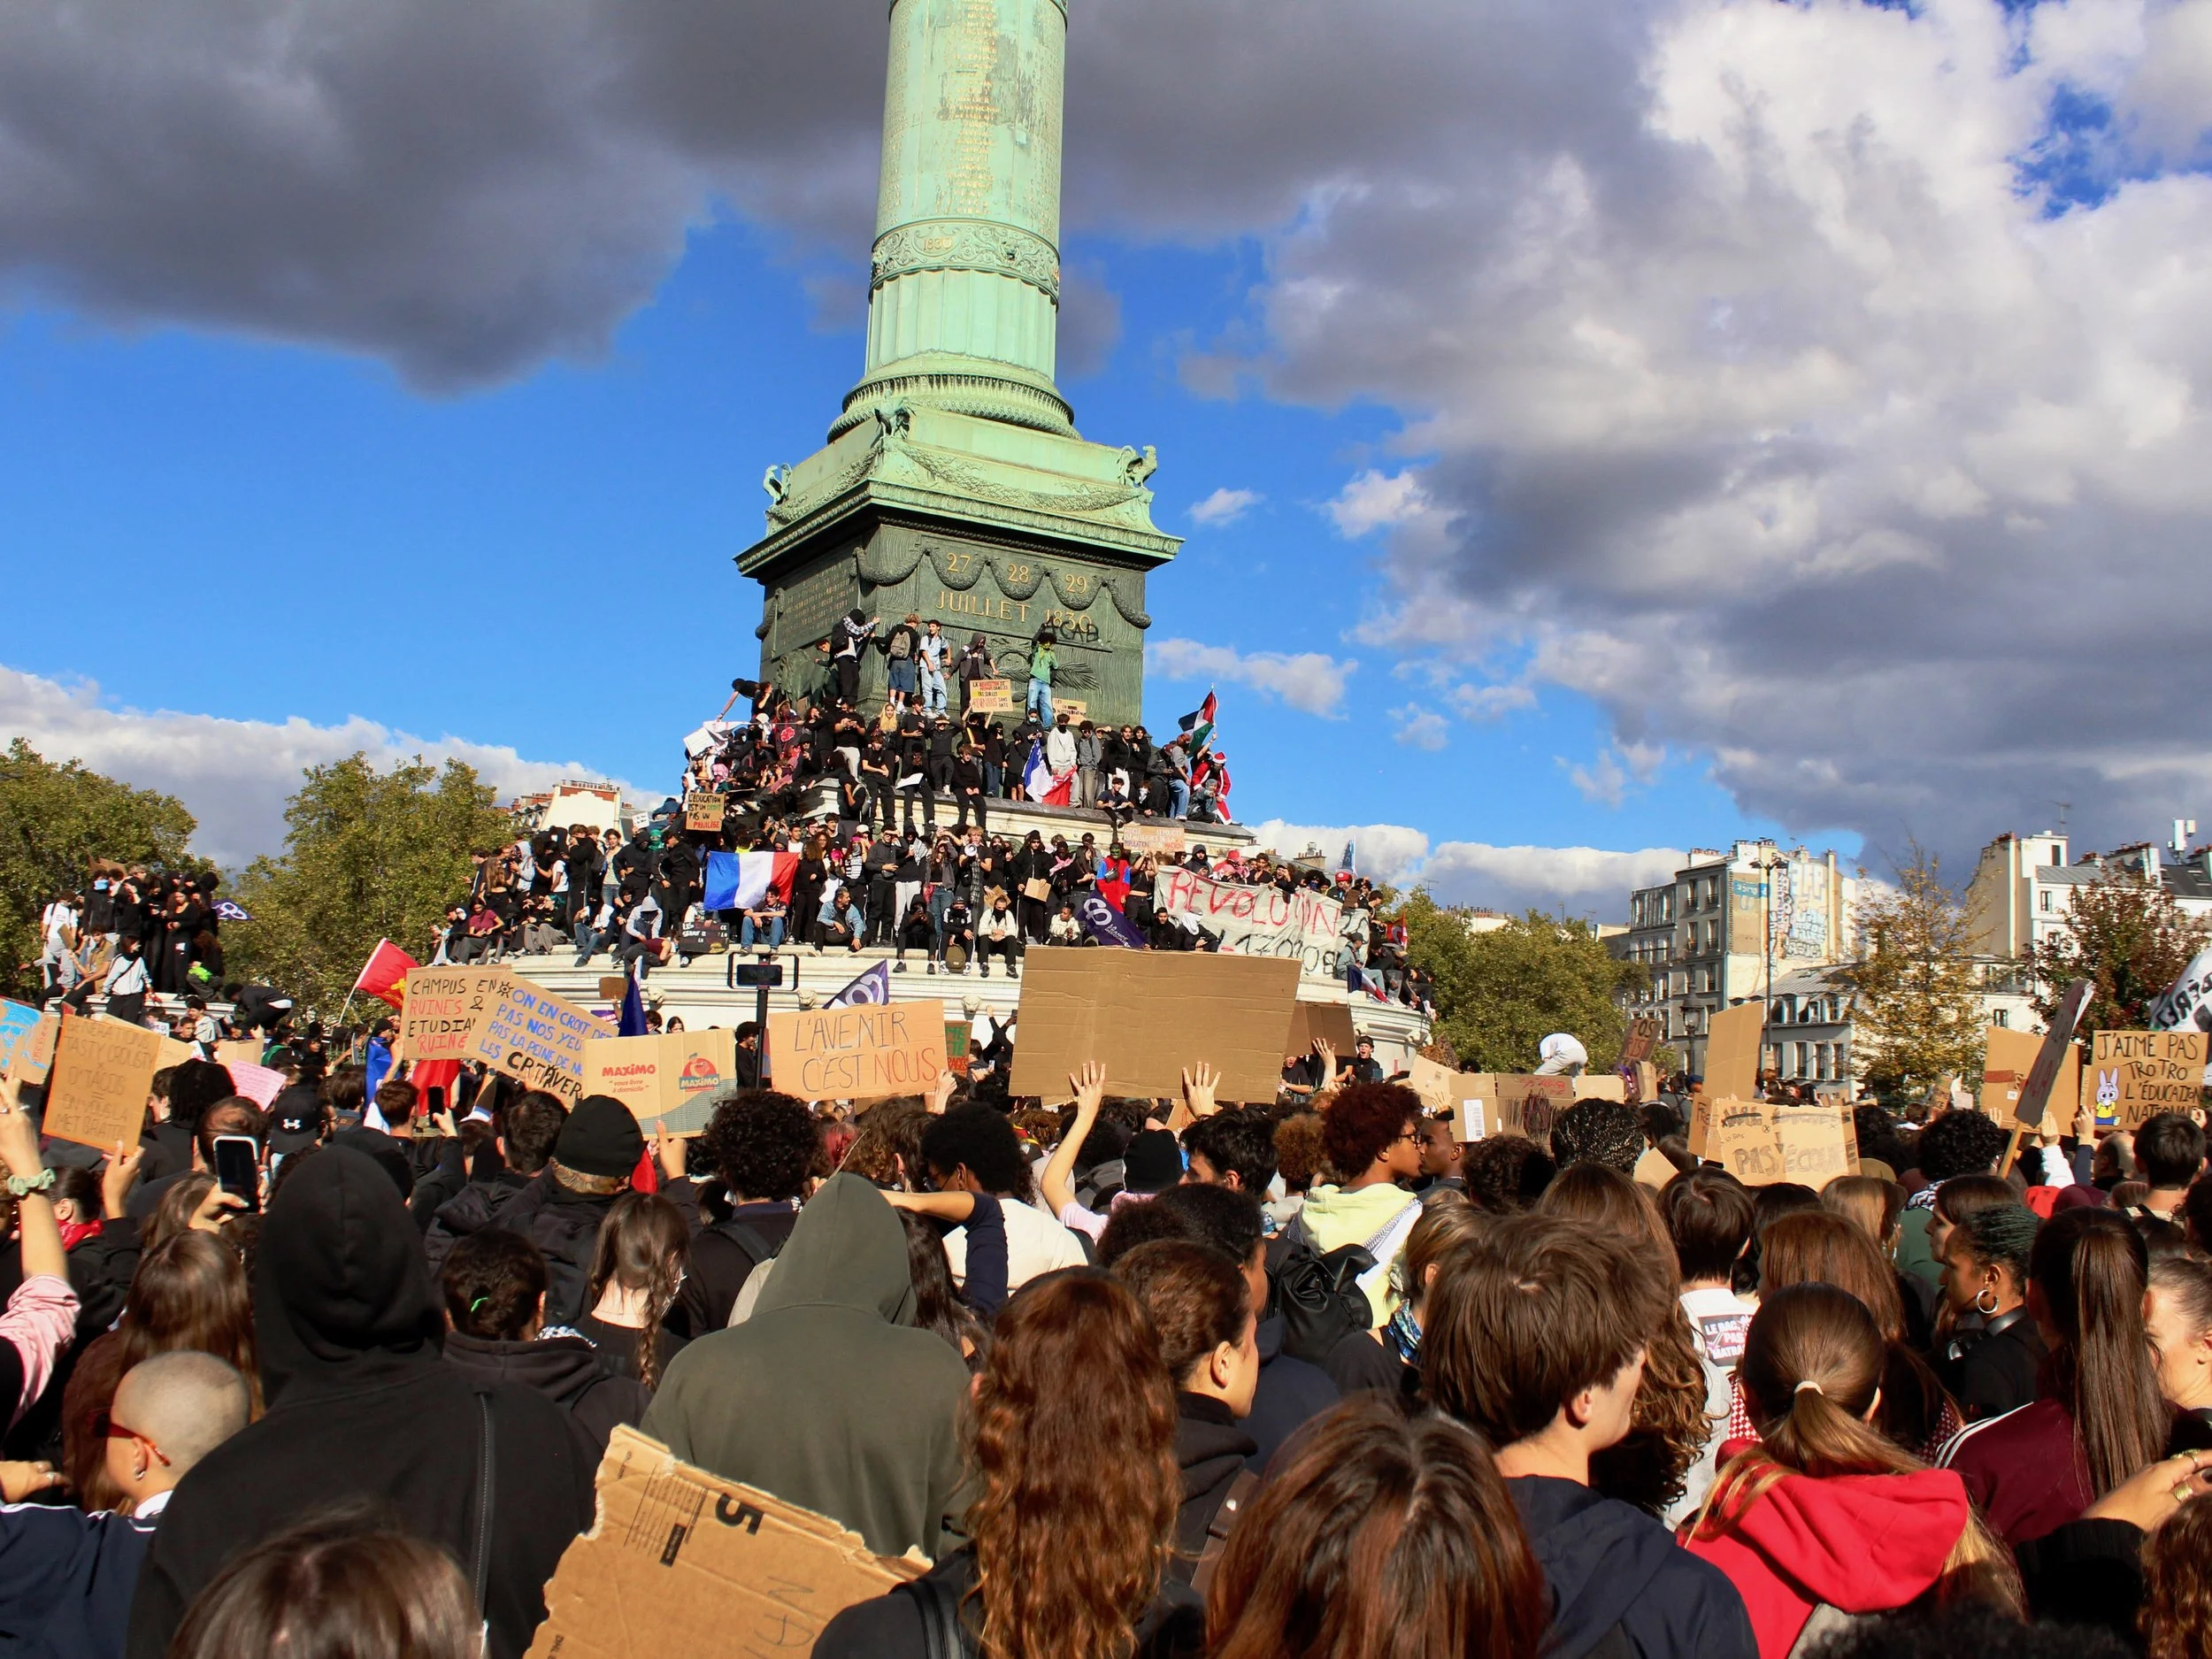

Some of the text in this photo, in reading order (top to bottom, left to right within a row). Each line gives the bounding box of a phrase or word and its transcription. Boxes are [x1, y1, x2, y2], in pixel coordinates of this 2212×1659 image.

[947, 552, 971, 573] 27
[1008, 563, 1029, 584] 28
[1065, 573, 1087, 594] 29
[935, 591, 1031, 623] JUILLET
[411, 978, 497, 995] CAMPUS EN
[409, 998, 463, 1017] RUINES
[511, 989, 537, 1010] ON
[537, 1002, 561, 1020] EN
[559, 1011, 592, 1035] CROIT
[408, 1018, 476, 1038] ETUDIA
[495, 1002, 524, 1027] PAS
[526, 1018, 556, 1041] NOS
[795, 1011, 909, 1051] L'AVENIR
[479, 1038, 502, 1060] LES
[488, 1020, 511, 1041] PAS
[509, 1032, 526, 1048] LA
[528, 1040, 556, 1064] PEINE
[556, 1054, 570, 1069] DE
[2097, 1033, 2198, 1060] J'AIME PAS
[874, 1048, 937, 1085] NOUS
[1734, 1144, 1780, 1176] PAS
[1724, 1333, 1744, 1343] PAS
[715, 1493, 764, 1536] 5
